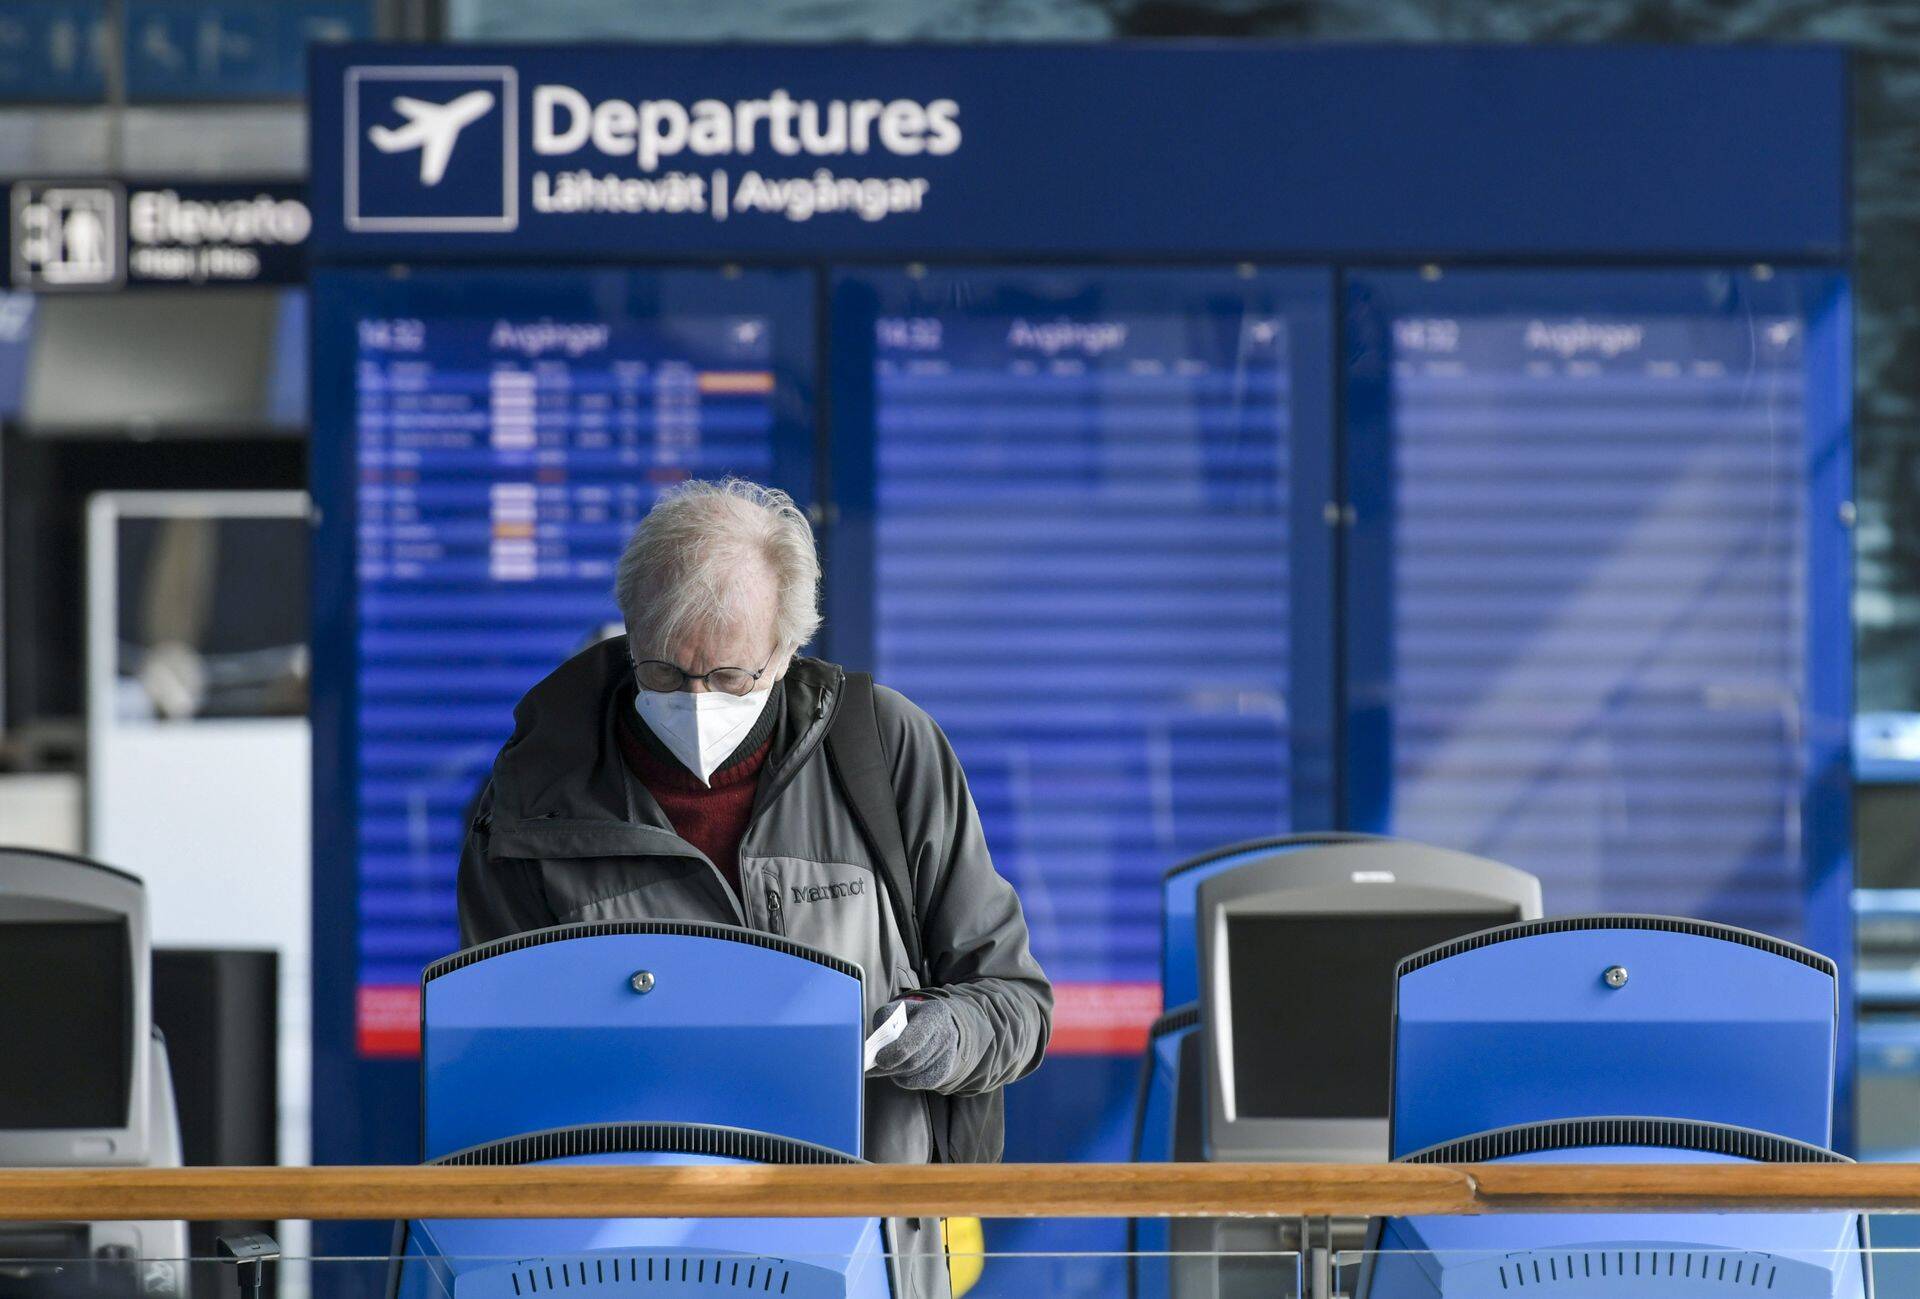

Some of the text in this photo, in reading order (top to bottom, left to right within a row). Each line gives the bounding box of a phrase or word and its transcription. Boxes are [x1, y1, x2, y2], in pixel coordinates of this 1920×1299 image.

[533, 85, 962, 172] Departures
[131, 190, 312, 245] Elevato
[533, 168, 706, 213] Lähtevät
[734, 168, 929, 222] Avgångar
[791, 877, 865, 904] Marmot
